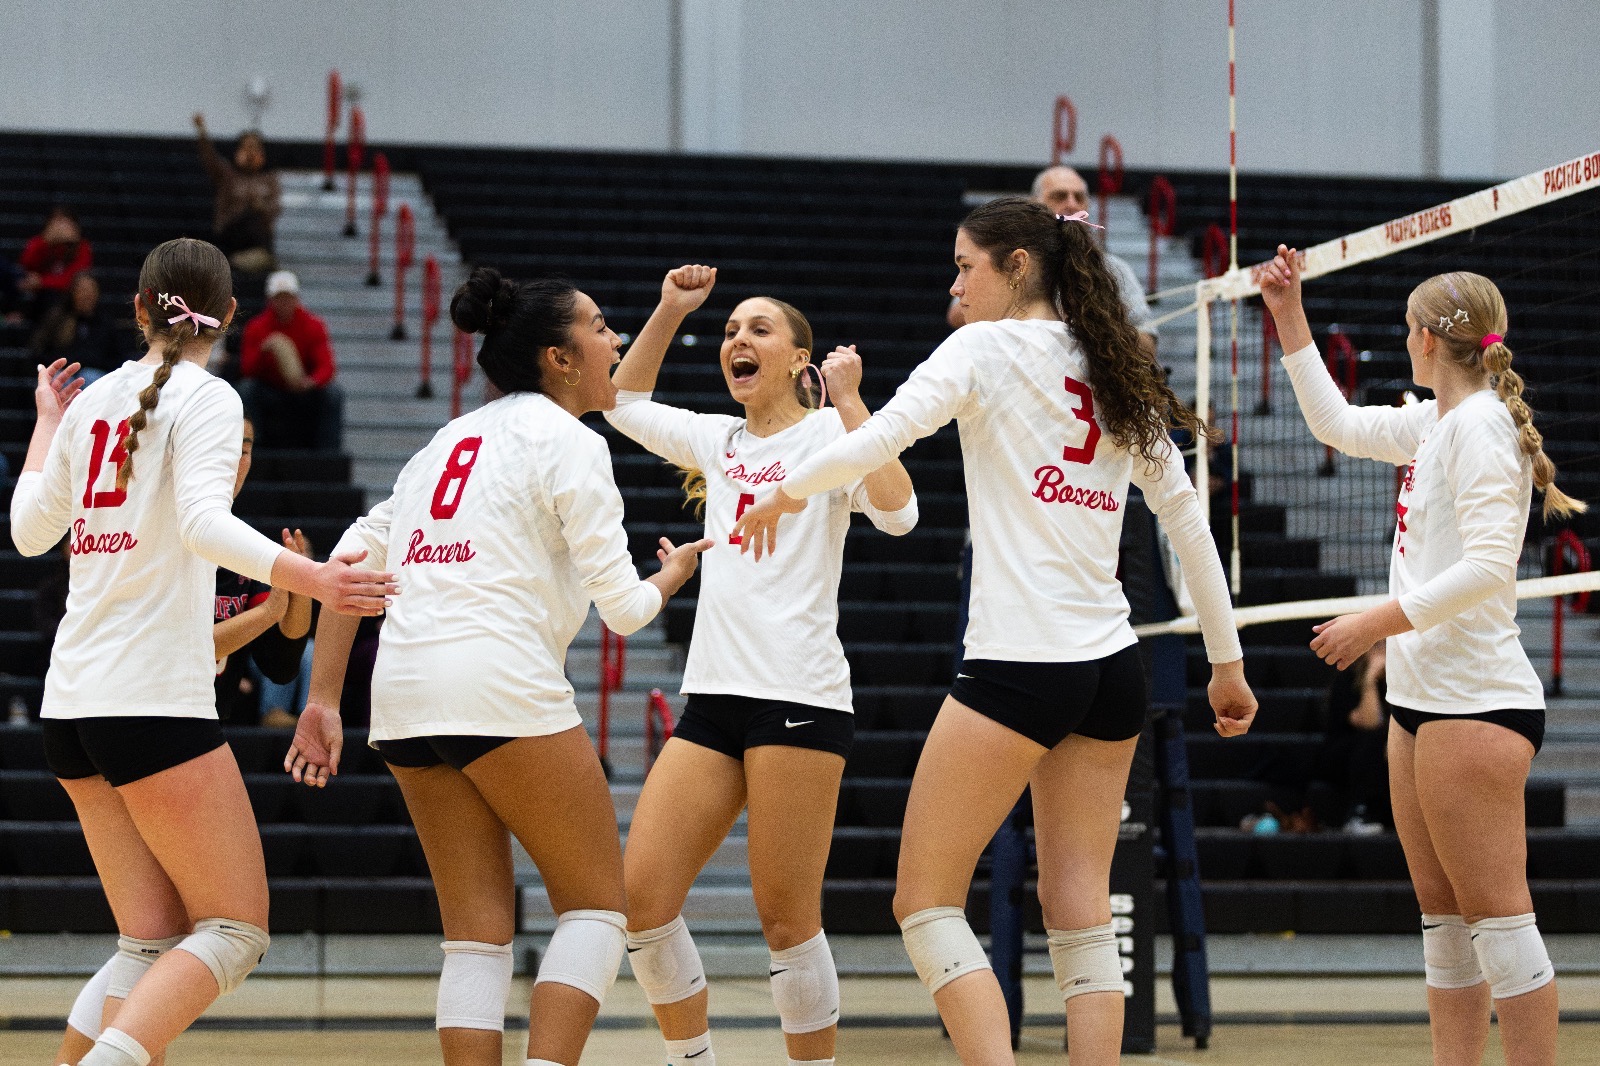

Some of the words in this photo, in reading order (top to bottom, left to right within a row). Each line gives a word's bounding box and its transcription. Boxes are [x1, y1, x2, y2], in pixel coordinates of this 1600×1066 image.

[1543, 160, 1582, 195] PACIFIC
[1584, 153, 1600, 181] BO
[1062, 375, 1102, 465] 3
[82, 416, 131, 509] 13
[430, 436, 483, 521] 8
[1031, 465, 1119, 512] Boxers
[401, 528, 476, 566] Boxers
